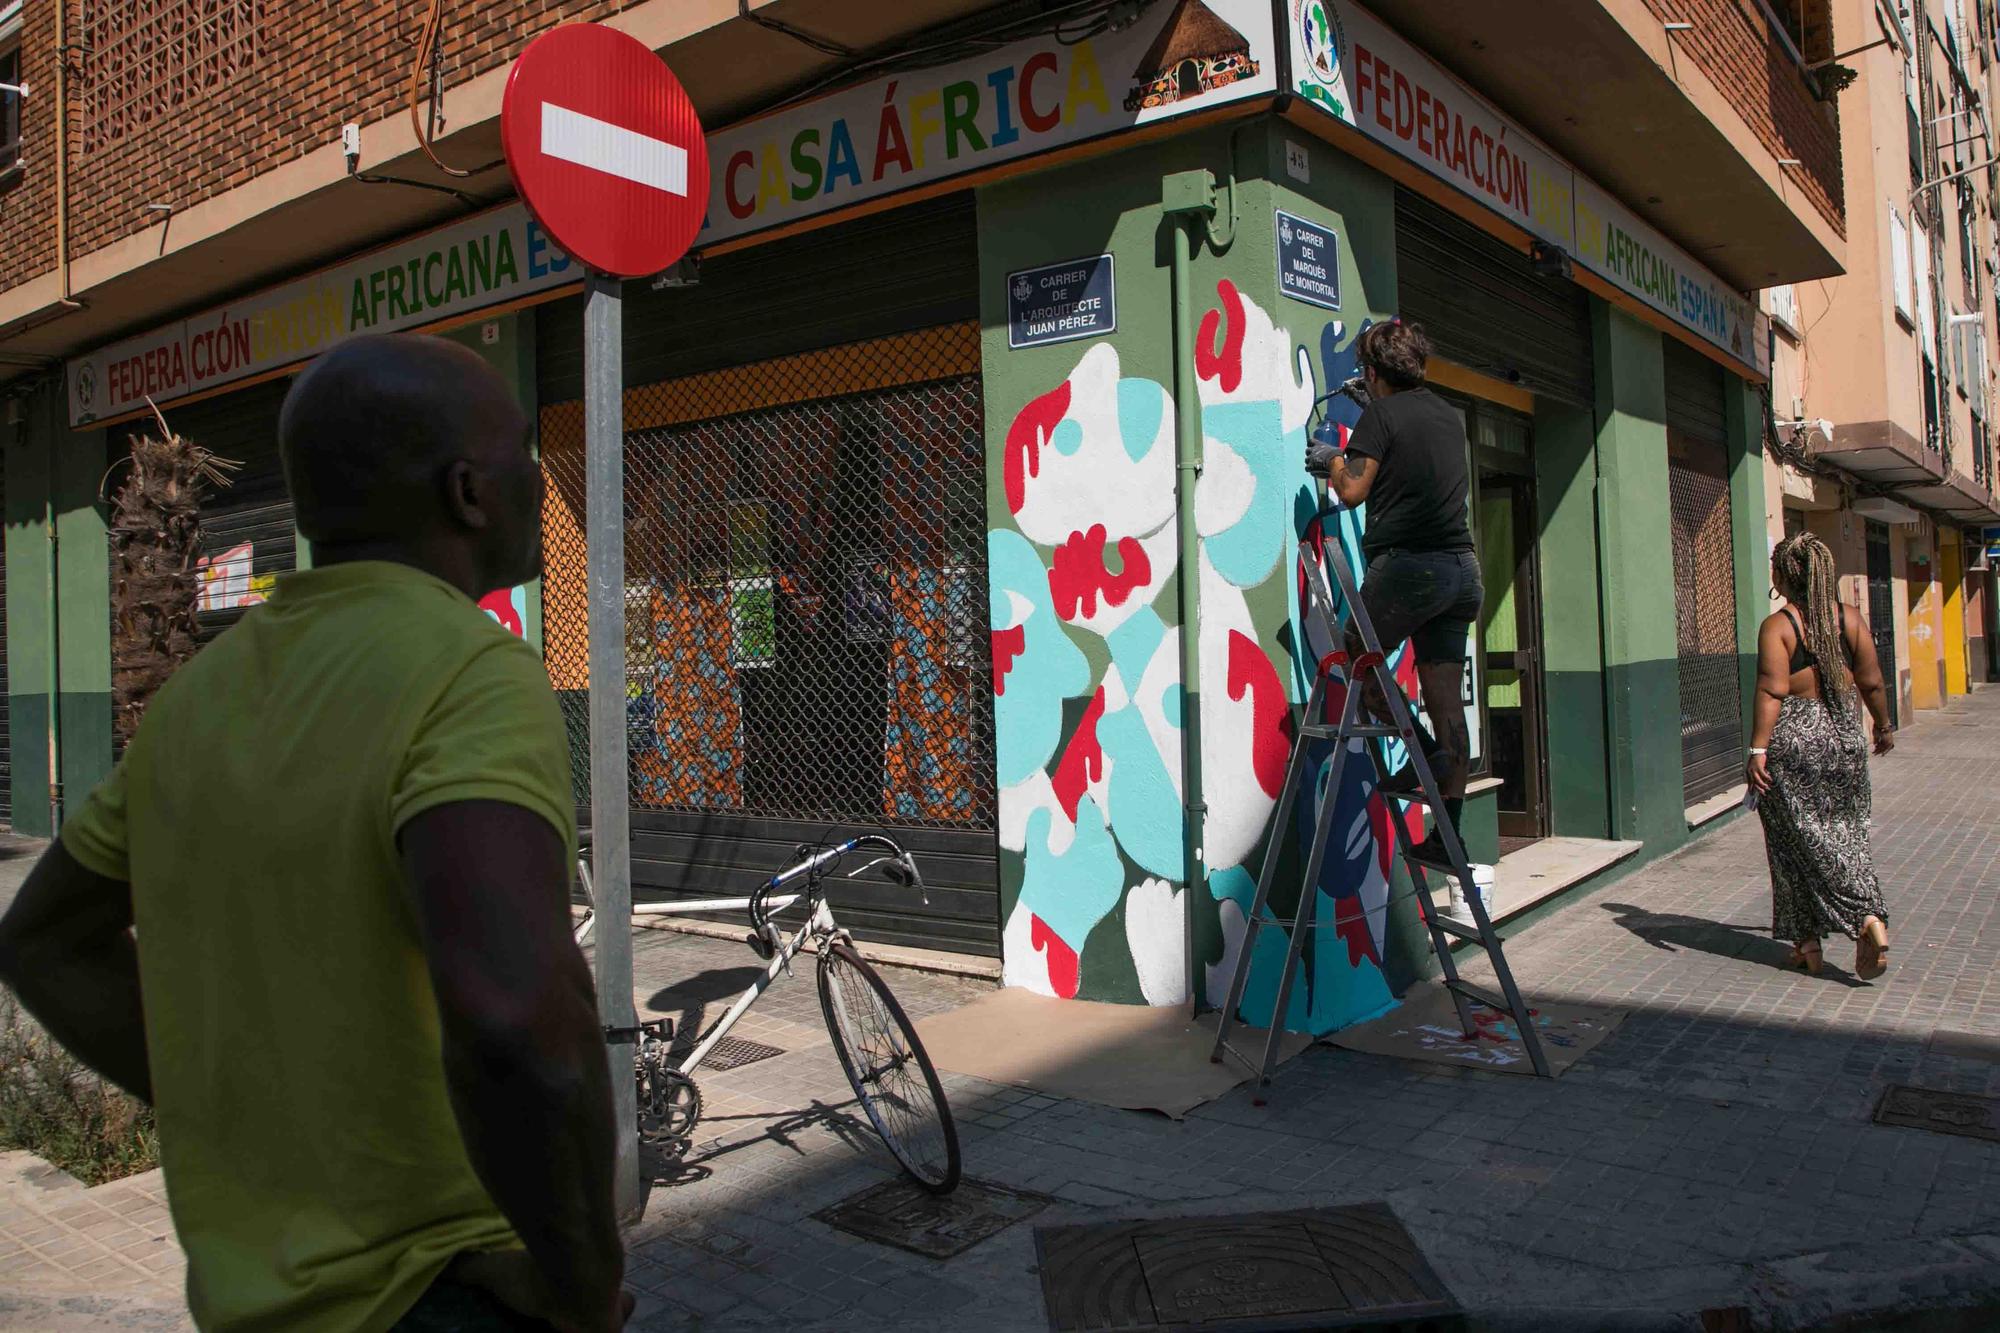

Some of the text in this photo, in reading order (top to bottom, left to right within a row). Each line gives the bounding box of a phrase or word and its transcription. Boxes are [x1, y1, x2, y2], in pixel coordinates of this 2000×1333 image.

[725, 40, 1112, 220] CASA ÁFRICA
[1355, 44, 1529, 216] FEDERACIÓN
[1606, 222, 1679, 312] AFRICANA
[1296, 228, 1324, 249] CARRER
[1302, 246, 1316, 261] DEL
[1040, 270, 1087, 288] CARRER
[1284, 271, 1336, 299] DE MONTORTAL
[1052, 288, 1068, 301] DE
[108, 312, 250, 406] FEDERACIÓN
[350, 228, 519, 332] AFRICANA
[1021, 297, 1101, 322] L'ARQUITECTE
[1026, 313, 1097, 336] JUAN PÉREZ
